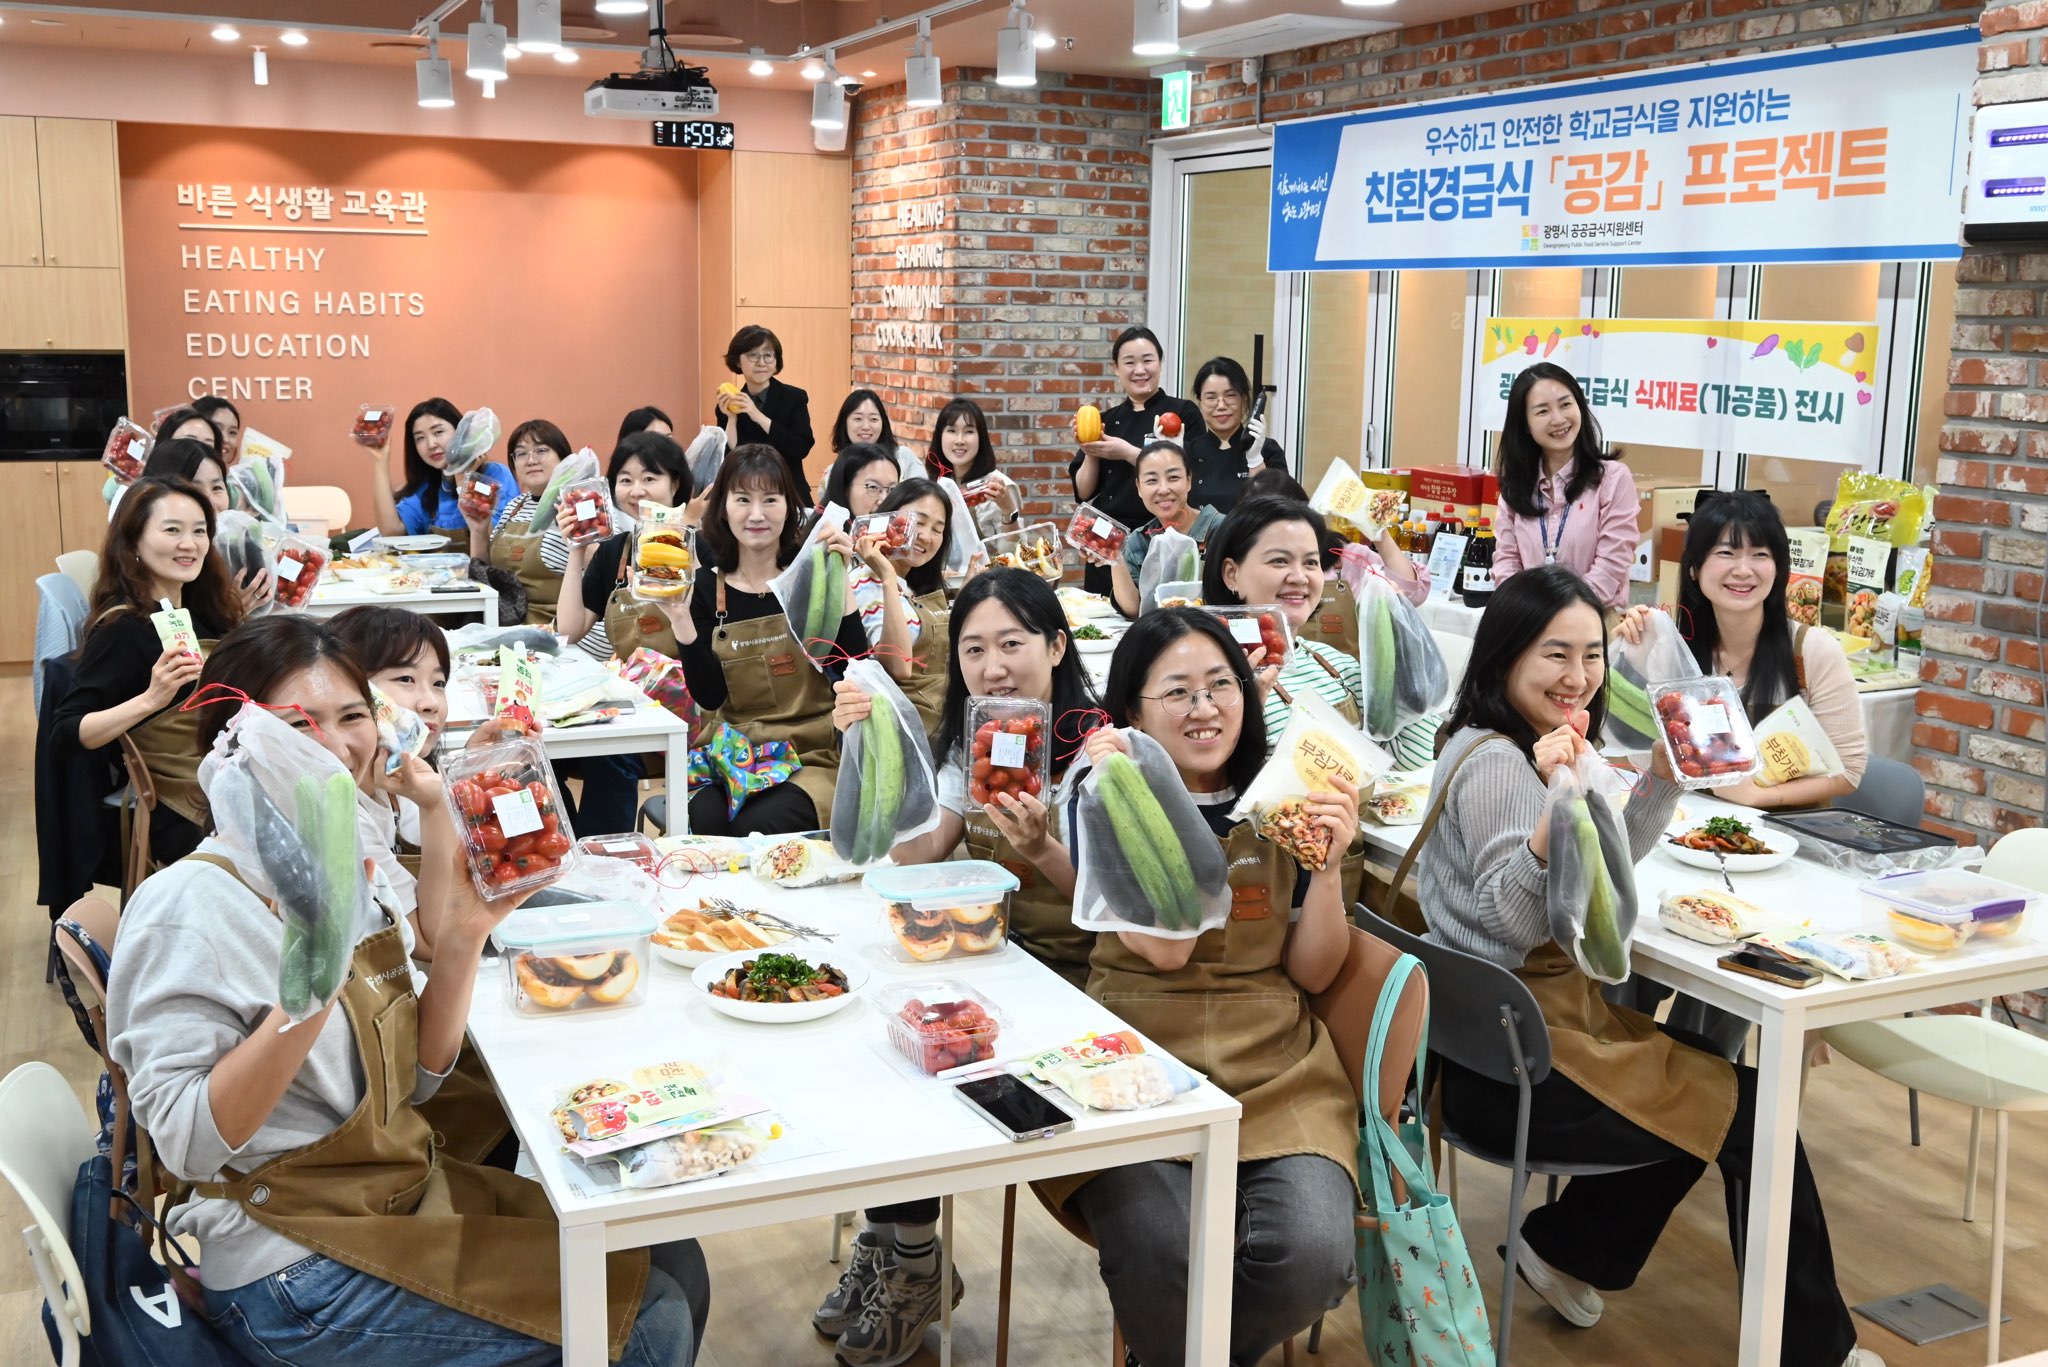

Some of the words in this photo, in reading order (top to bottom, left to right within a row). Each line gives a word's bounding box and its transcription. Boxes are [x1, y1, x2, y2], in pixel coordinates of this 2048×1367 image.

[672, 123, 714, 147] 11:59
[1426, 122, 1495, 156] 우수하고
[1503, 114, 1562, 149] 안전한
[1570, 100, 1680, 141] 학교급식을
[1688, 88, 1790, 130] 지원하는
[1365, 159, 1533, 224] 친환경급식
[1683, 127, 1888, 207] 프로젝트
[177, 184, 237, 218] 바른
[245, 186, 334, 220] 식생활
[341, 189, 428, 223] 교육관
[897, 200, 944, 229] HEALING
[1543, 224, 1569, 240] 광명시
[1571, 220, 1643, 239] 공공급식지원센터
[181, 244, 325, 271] HEALTHY
[895, 243, 943, 268] SHARING
[184, 289, 300, 315] EATING
[314, 291, 425, 316] HABITS
[883, 285, 943, 309] COMMUNAL
[186, 333, 370, 357] EDUCATION
[187, 376, 313, 400] CENTER
[1795, 390, 1844, 425] 전시
[514, 679, 534, 696] 사과
[1765, 737, 1800, 779] 부침가루
[129, 1282, 182, 1329] A
